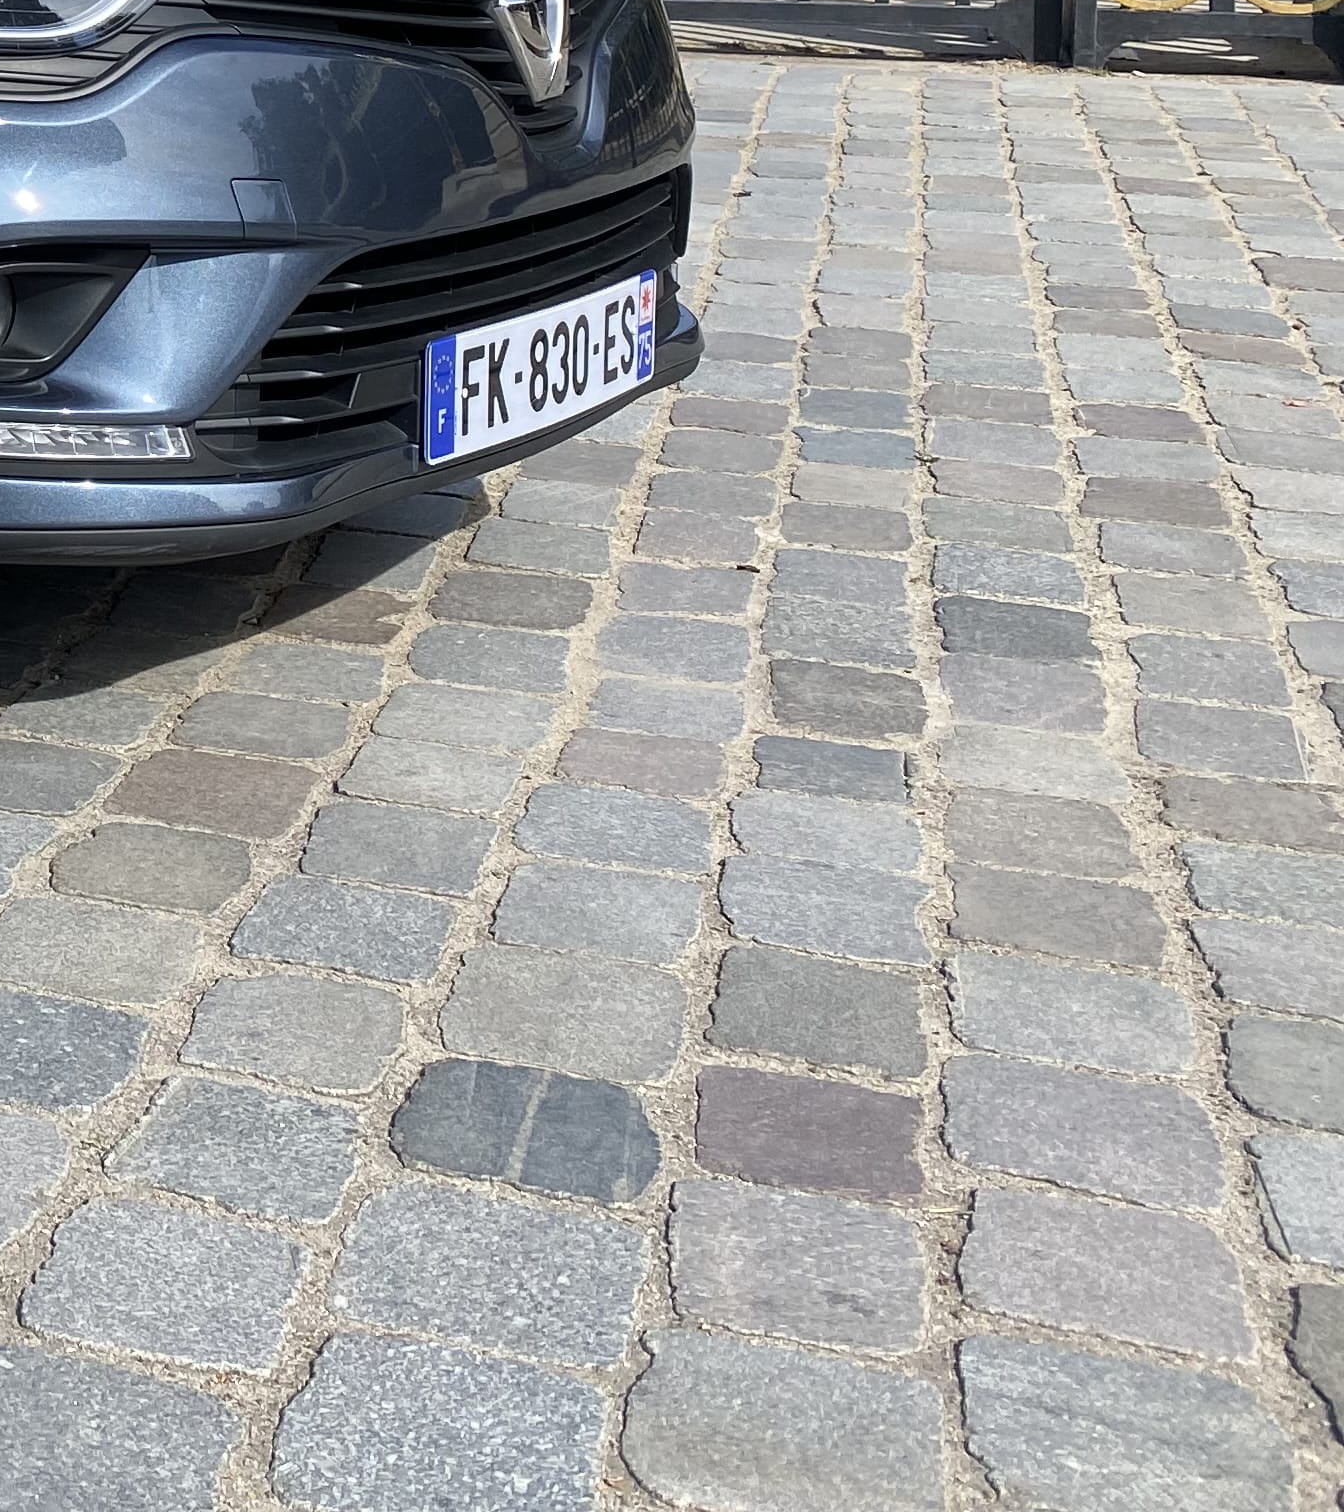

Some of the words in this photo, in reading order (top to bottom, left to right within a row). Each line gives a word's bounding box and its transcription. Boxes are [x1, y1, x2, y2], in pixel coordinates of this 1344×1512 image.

[461, 295, 636, 436] FK-830-ES
[638, 330, 652, 369] 75
[438, 408, 447, 434] F
